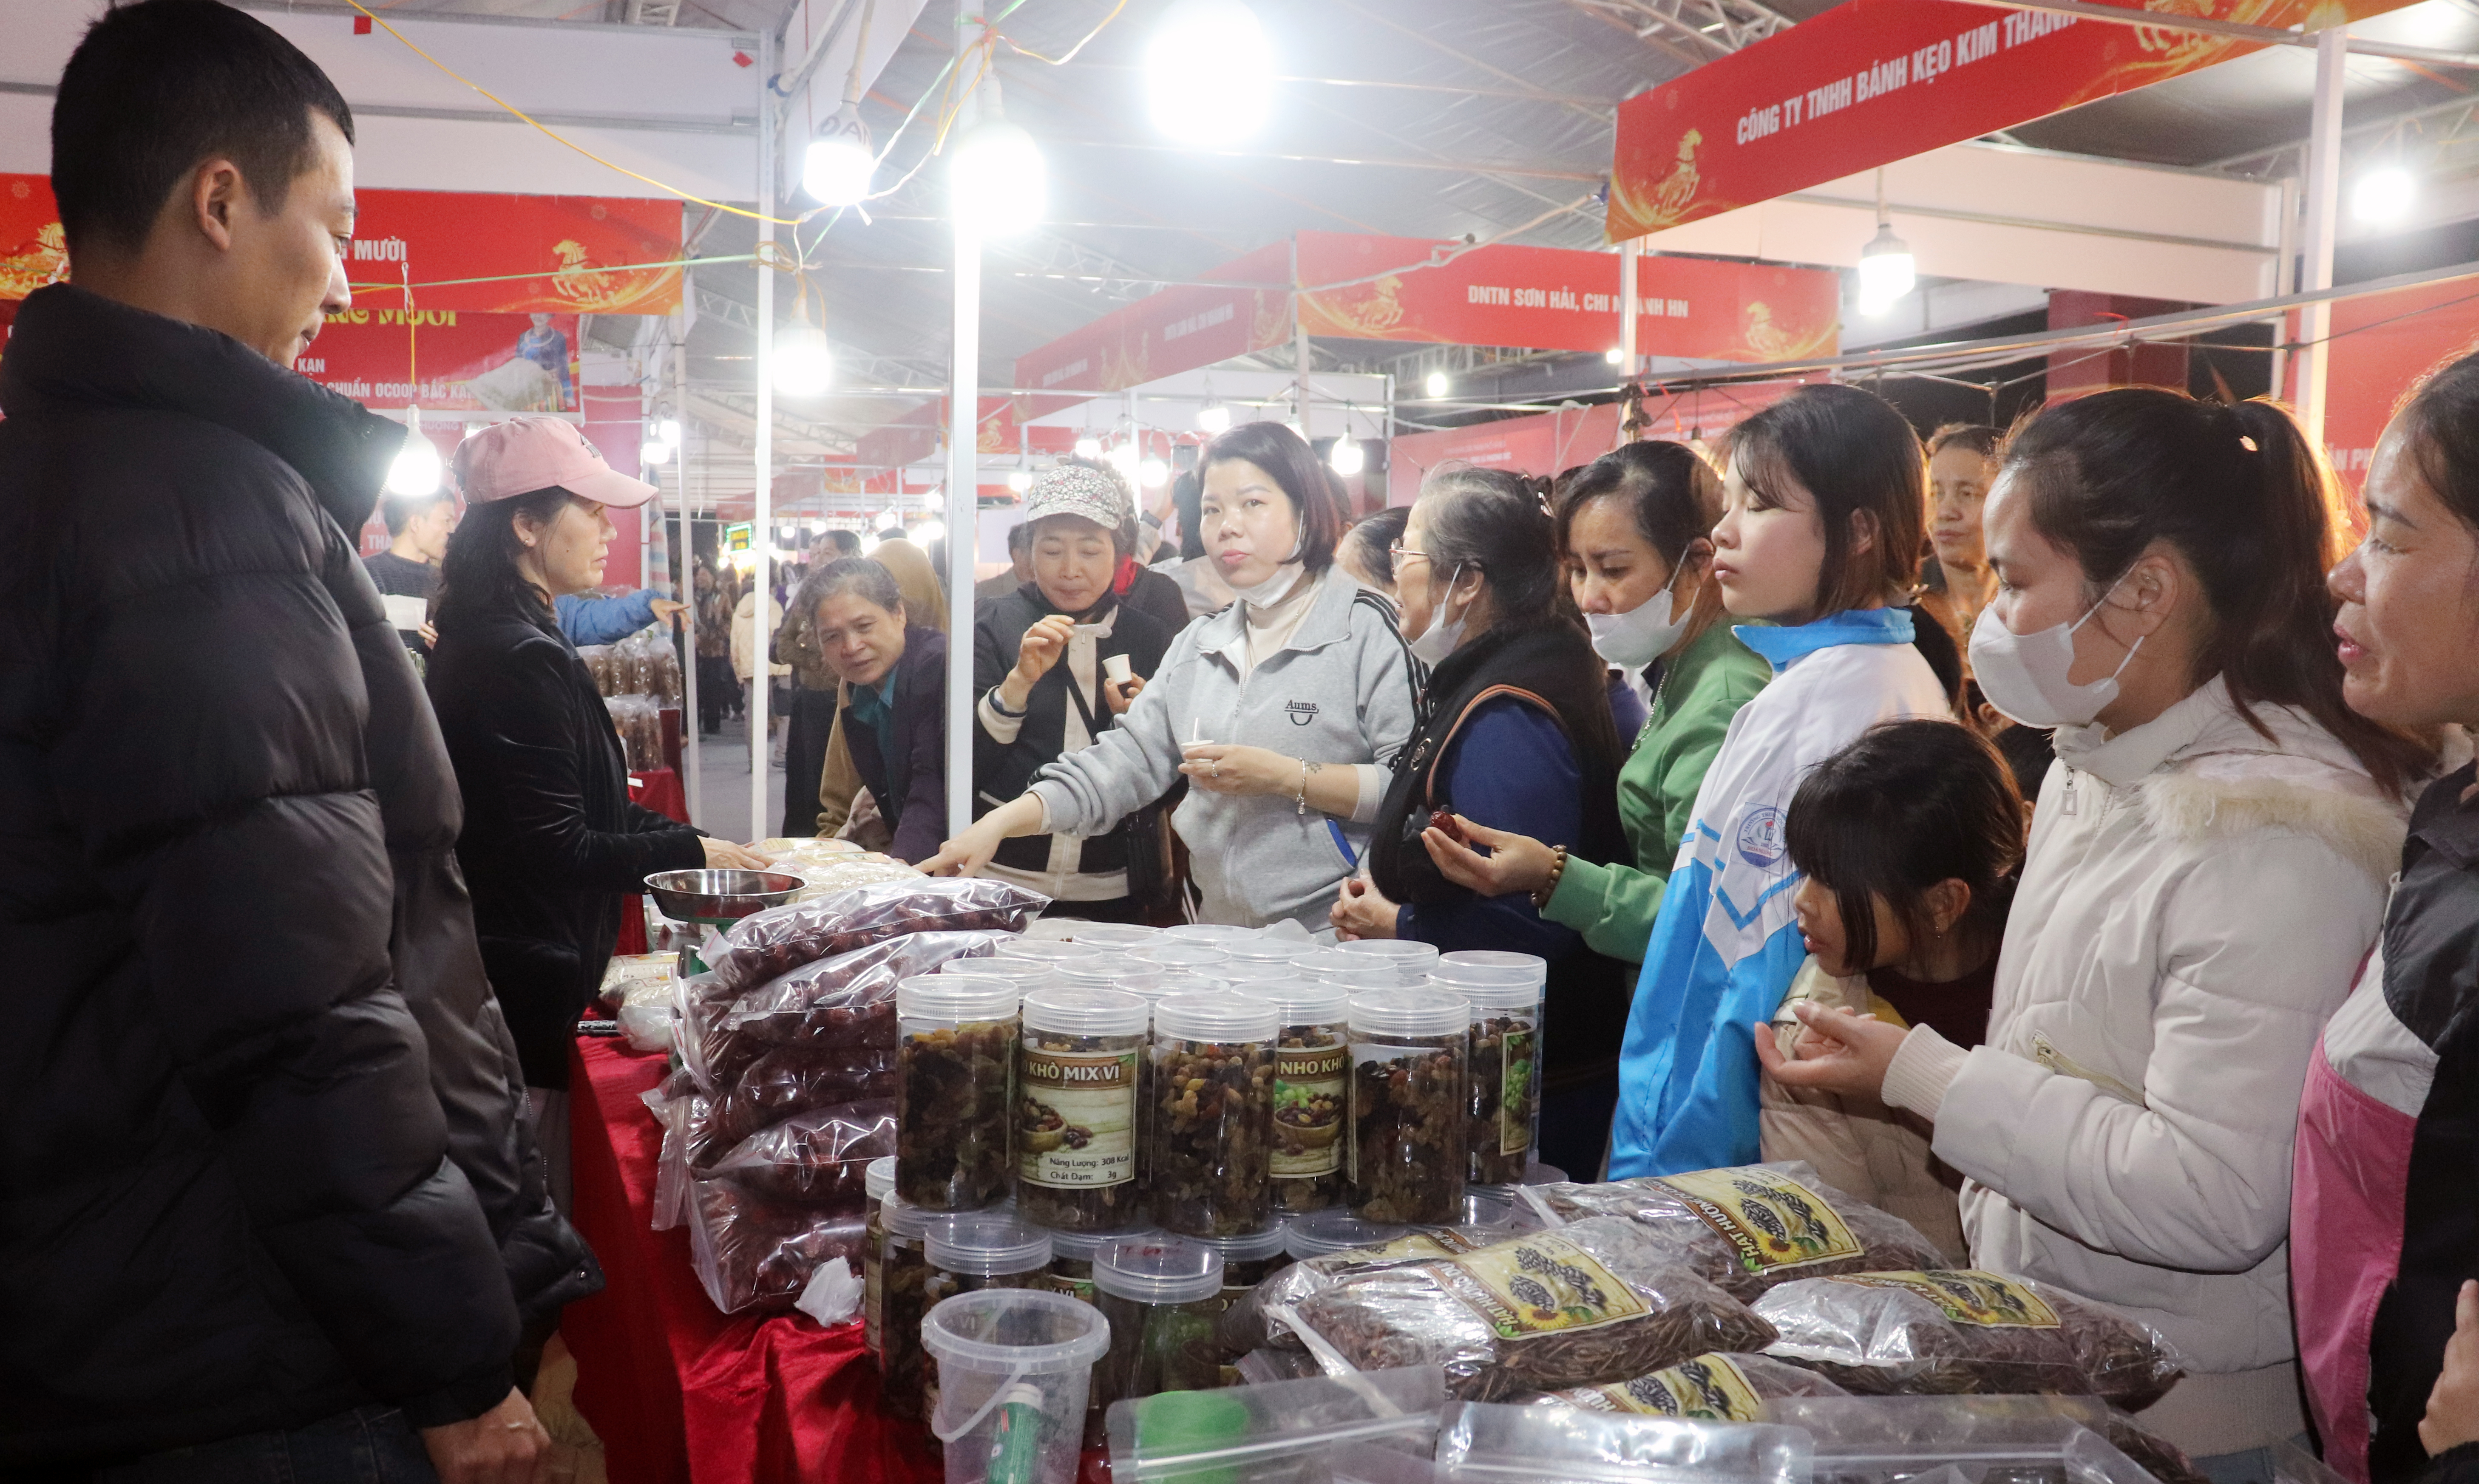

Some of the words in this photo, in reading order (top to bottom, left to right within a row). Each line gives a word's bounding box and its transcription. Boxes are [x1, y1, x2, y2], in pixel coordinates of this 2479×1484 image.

[1737, 107, 1780, 145] CÔNG
[1784, 95, 1803, 127] TY
[1807, 76, 1852, 120] TNHH
[1856, 59, 1908, 103] BÁNH
[1913, 40, 1951, 84] KẸO
[1957, 21, 1997, 67] KIM
[354, 235, 407, 261] MƯỜI
[1468, 285, 1510, 305] DNTN
[1514, 287, 1546, 307] SƠN
[1583, 293, 1609, 312] CHI
[1667, 299, 1688, 317] HN
[298, 358, 325, 376] KẠN
[1285, 700, 1317, 711] Aums
[1029, 1062, 1060, 1079] KHÔ
[1064, 1066, 1099, 1080] MIX
[1103, 1065, 1119, 1082] VỊ
[1280, 1061, 1319, 1075] NHO
[1101, 1158, 1115, 1166] 308
[1107, 1171, 1116, 1179] 3g
[1728, 1232, 1760, 1257] HẠT
